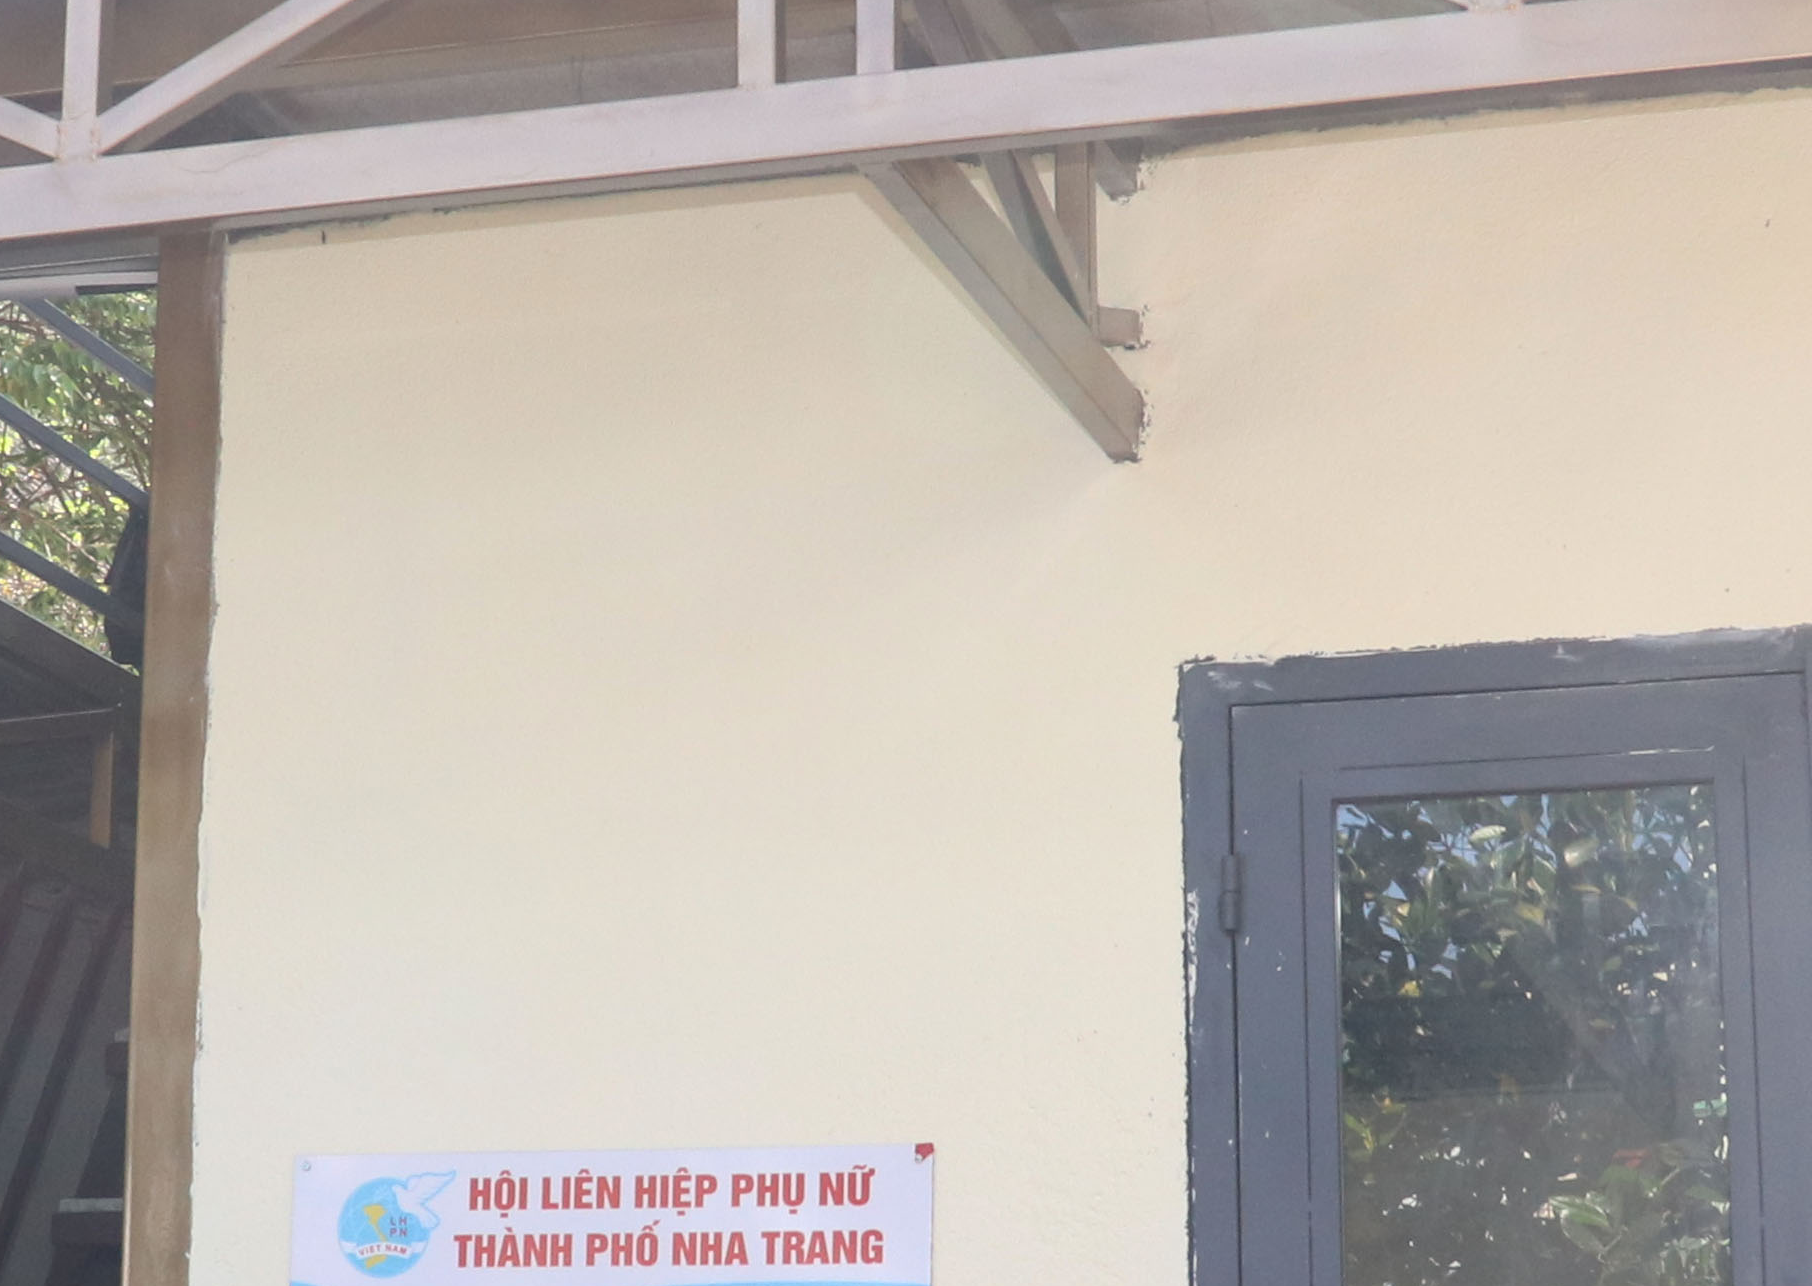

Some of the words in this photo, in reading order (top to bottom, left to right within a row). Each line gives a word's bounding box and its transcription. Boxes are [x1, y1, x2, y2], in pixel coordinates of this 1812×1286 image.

[468, 1170, 529, 1219] HỘI
[541, 1168, 623, 1211] LIÊN
[634, 1167, 718, 1217] HIỆP
[731, 1172, 807, 1215] PHỤ
[819, 1164, 875, 1208] NỮ
[453, 1226, 575, 1268] THÀNH
[585, 1220, 661, 1268] PHỐ
[671, 1230, 749, 1267] NHA
[760, 1228, 885, 1266] TRANG
